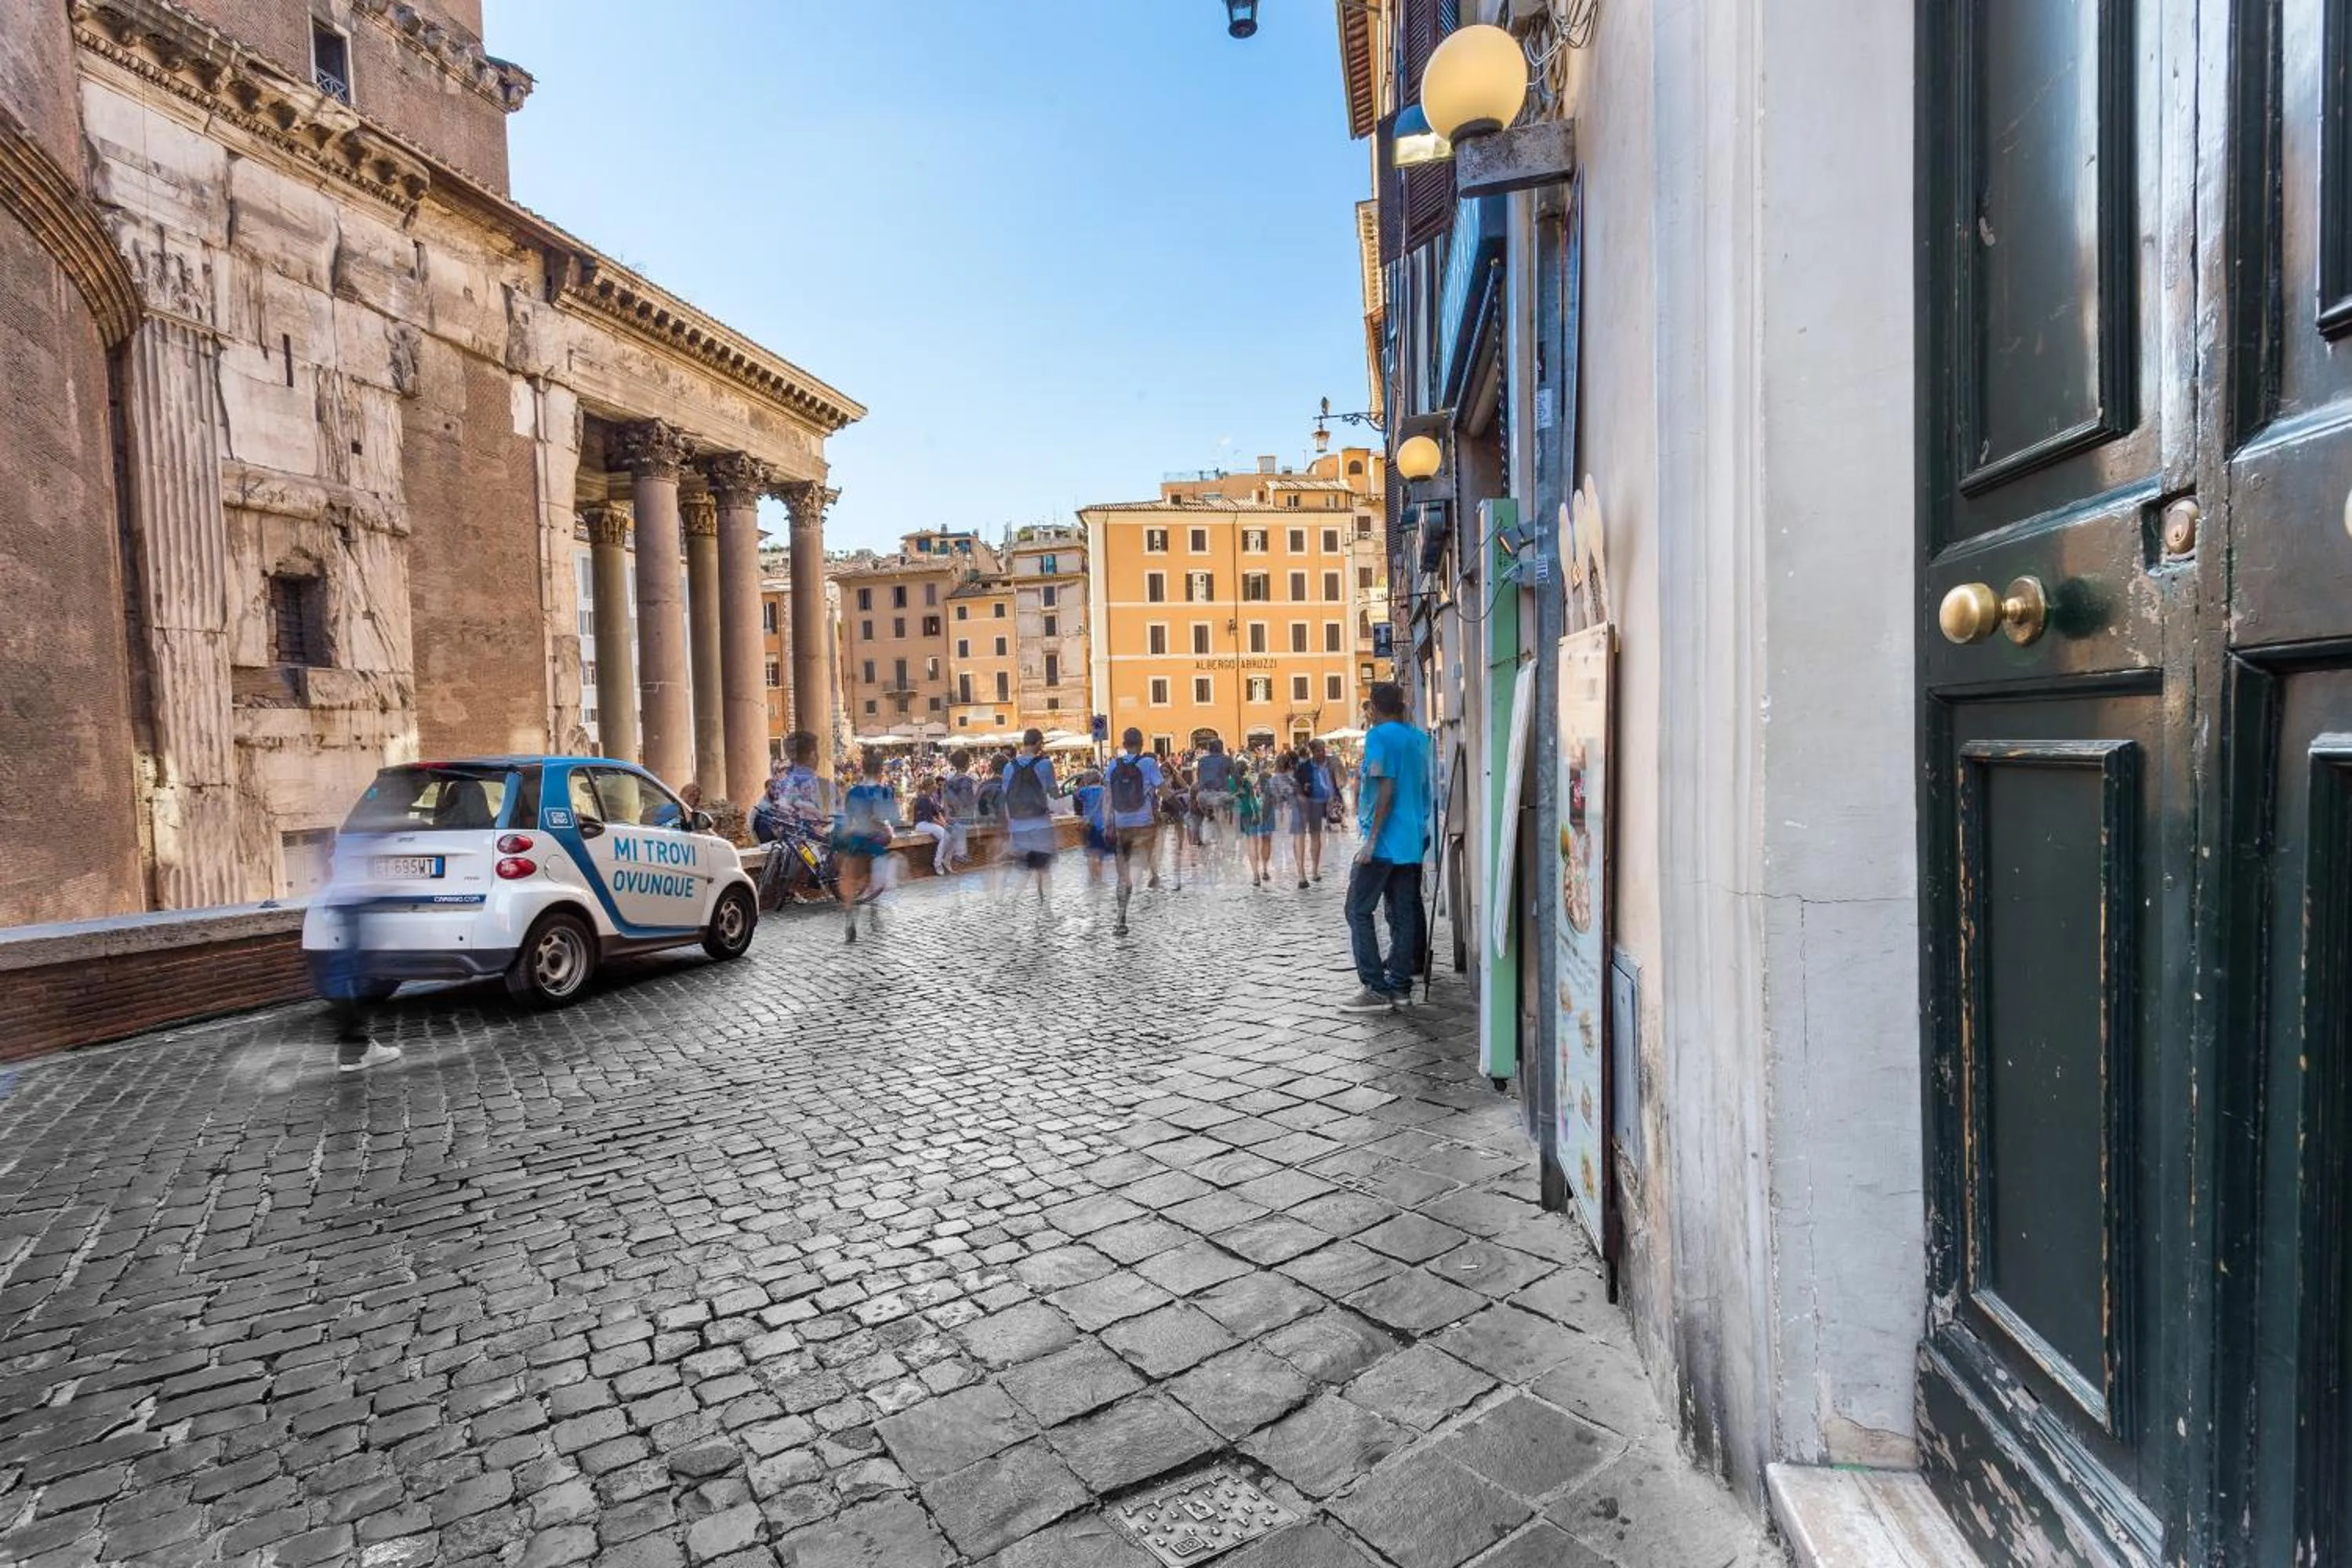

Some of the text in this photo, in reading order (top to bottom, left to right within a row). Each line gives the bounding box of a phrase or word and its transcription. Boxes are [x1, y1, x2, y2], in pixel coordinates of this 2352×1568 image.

[1196, 658, 1277, 670] ALBERGO ABRUZZI
[614, 837, 696, 866] MI TROVI
[613, 869, 695, 898] OVUNQUE
